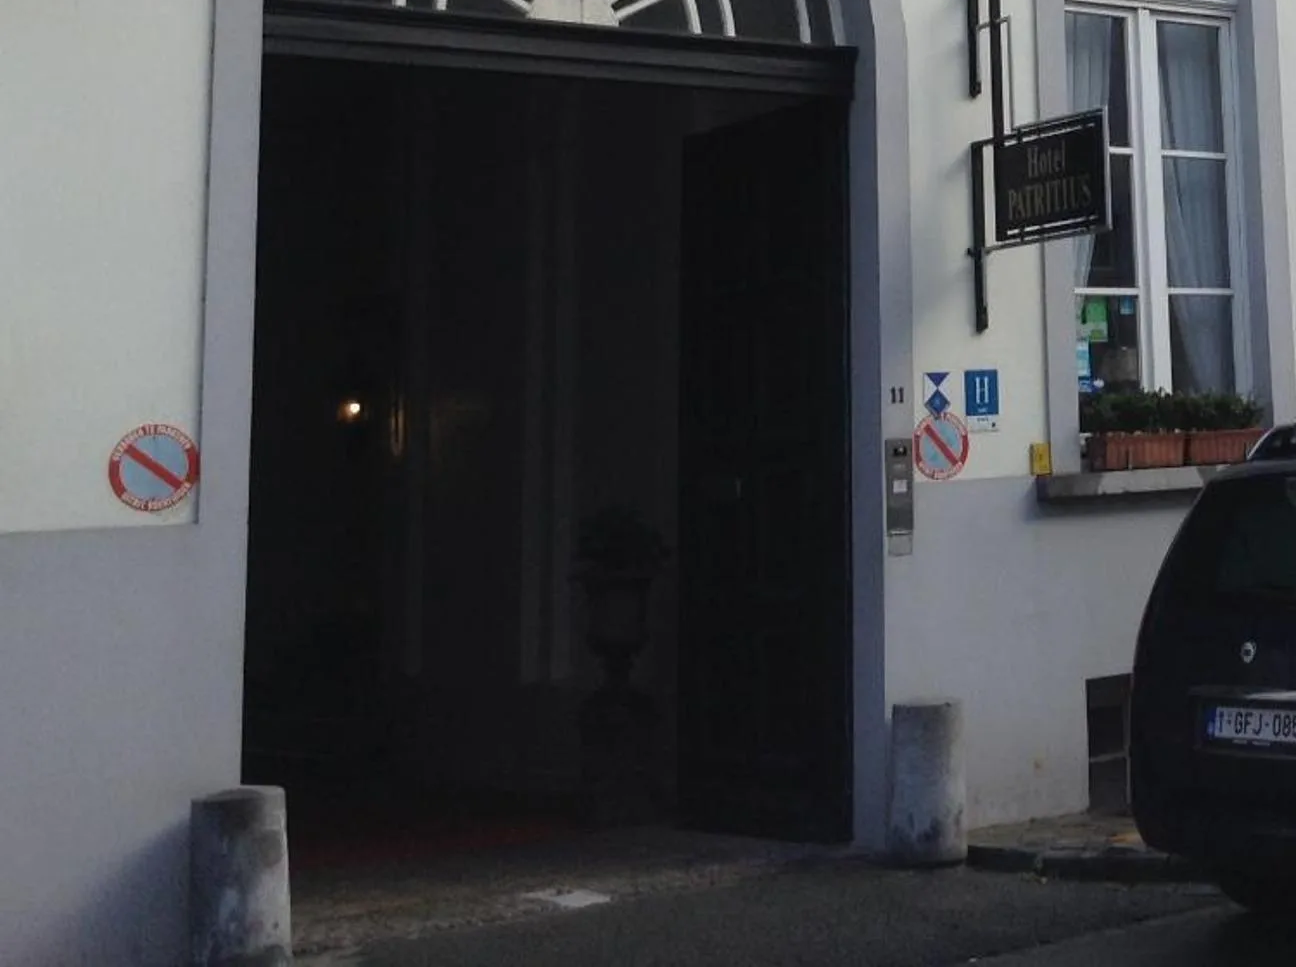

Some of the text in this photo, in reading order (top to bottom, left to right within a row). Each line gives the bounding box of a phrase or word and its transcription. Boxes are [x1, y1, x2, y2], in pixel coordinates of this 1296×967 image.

[1027, 140, 1066, 178] Hotel
[1008, 174, 1092, 220] PATRITIUS
[890, 386, 905, 404] 11
[975, 376, 990, 404] H
